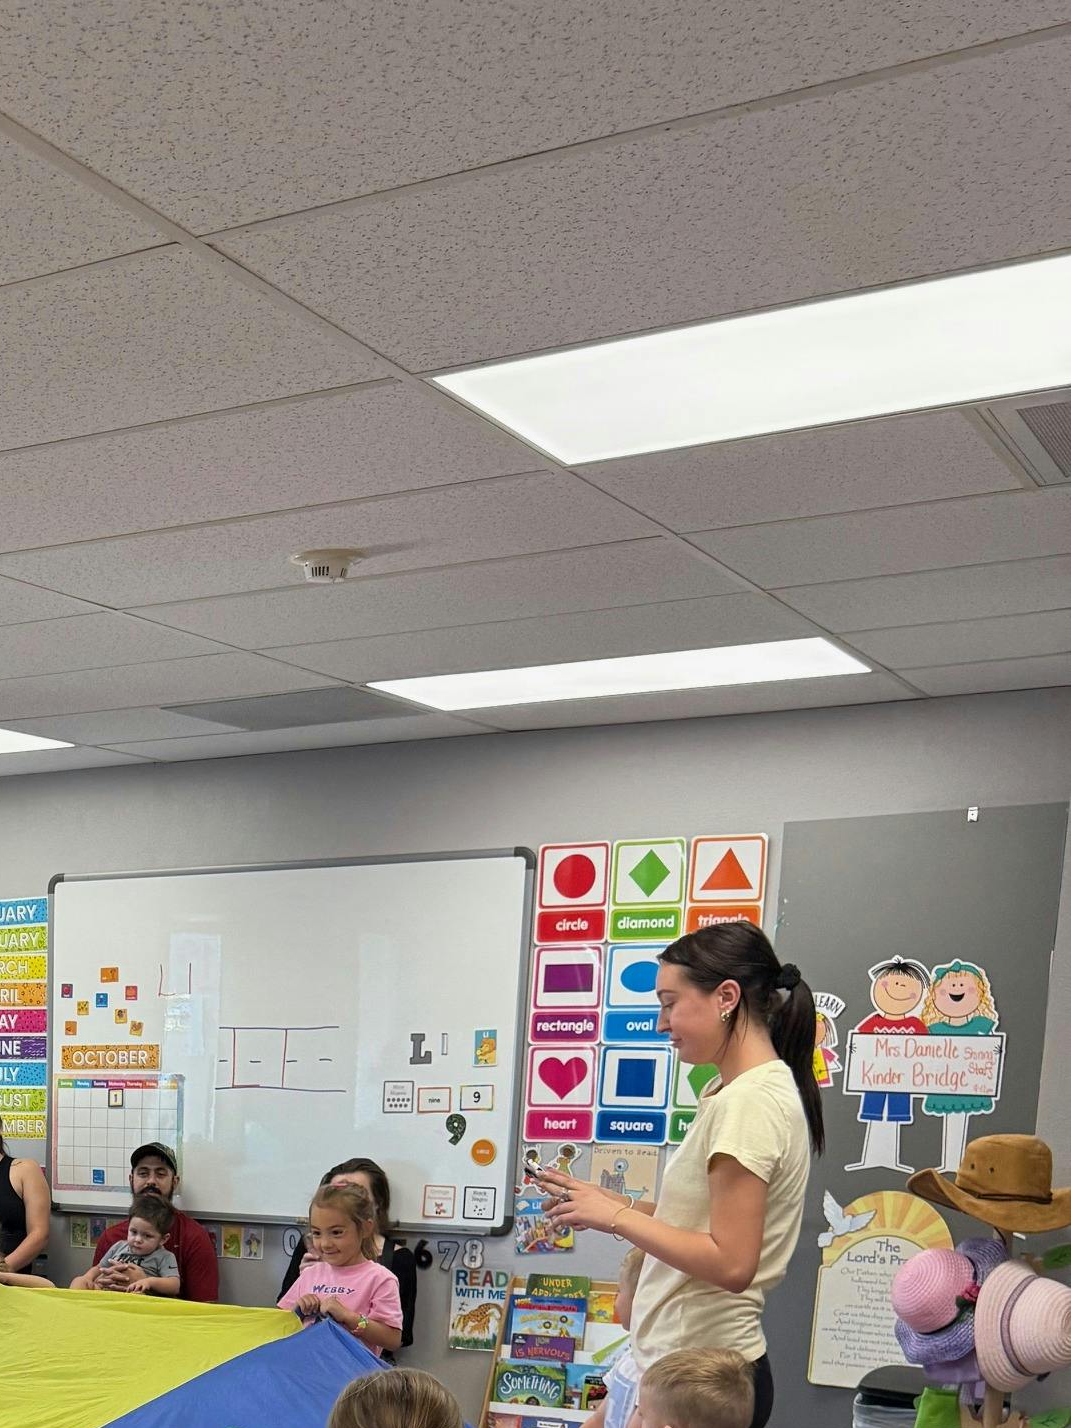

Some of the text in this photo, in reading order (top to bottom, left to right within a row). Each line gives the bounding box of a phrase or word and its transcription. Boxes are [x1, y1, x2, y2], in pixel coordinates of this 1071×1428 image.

[555, 918, 588, 931] circle
[617, 916, 675, 931] diamond
[815, 994, 841, 1013] LEARN
[536, 1018, 594, 1035] rectangle
[626, 1019, 654, 1032] oval
[410, 1033, 432, 1065] L
[875, 1038, 900, 1058] Mrs
[904, 1038, 960, 1058] Danielle
[73, 1050, 147, 1065] OCTOBER
[862, 1061, 968, 1092] Kinder Bridge
[473, 1092, 481, 1103] 9
[446, 1114, 467, 1146] 9
[544, 1117, 577, 1130] heart
[609, 1119, 654, 1134] square
[877, 1239, 900, 1252] The
[415, 1239, 484, 1272] 6 7 8
[847, 1250, 886, 1264] Lord's
[456, 1270, 508, 1287] READ
[542, 1278, 572, 1287] UNDER
[456, 1288, 506, 1300] WITH ME
[528, 1347, 569, 1360] NERVOUS
